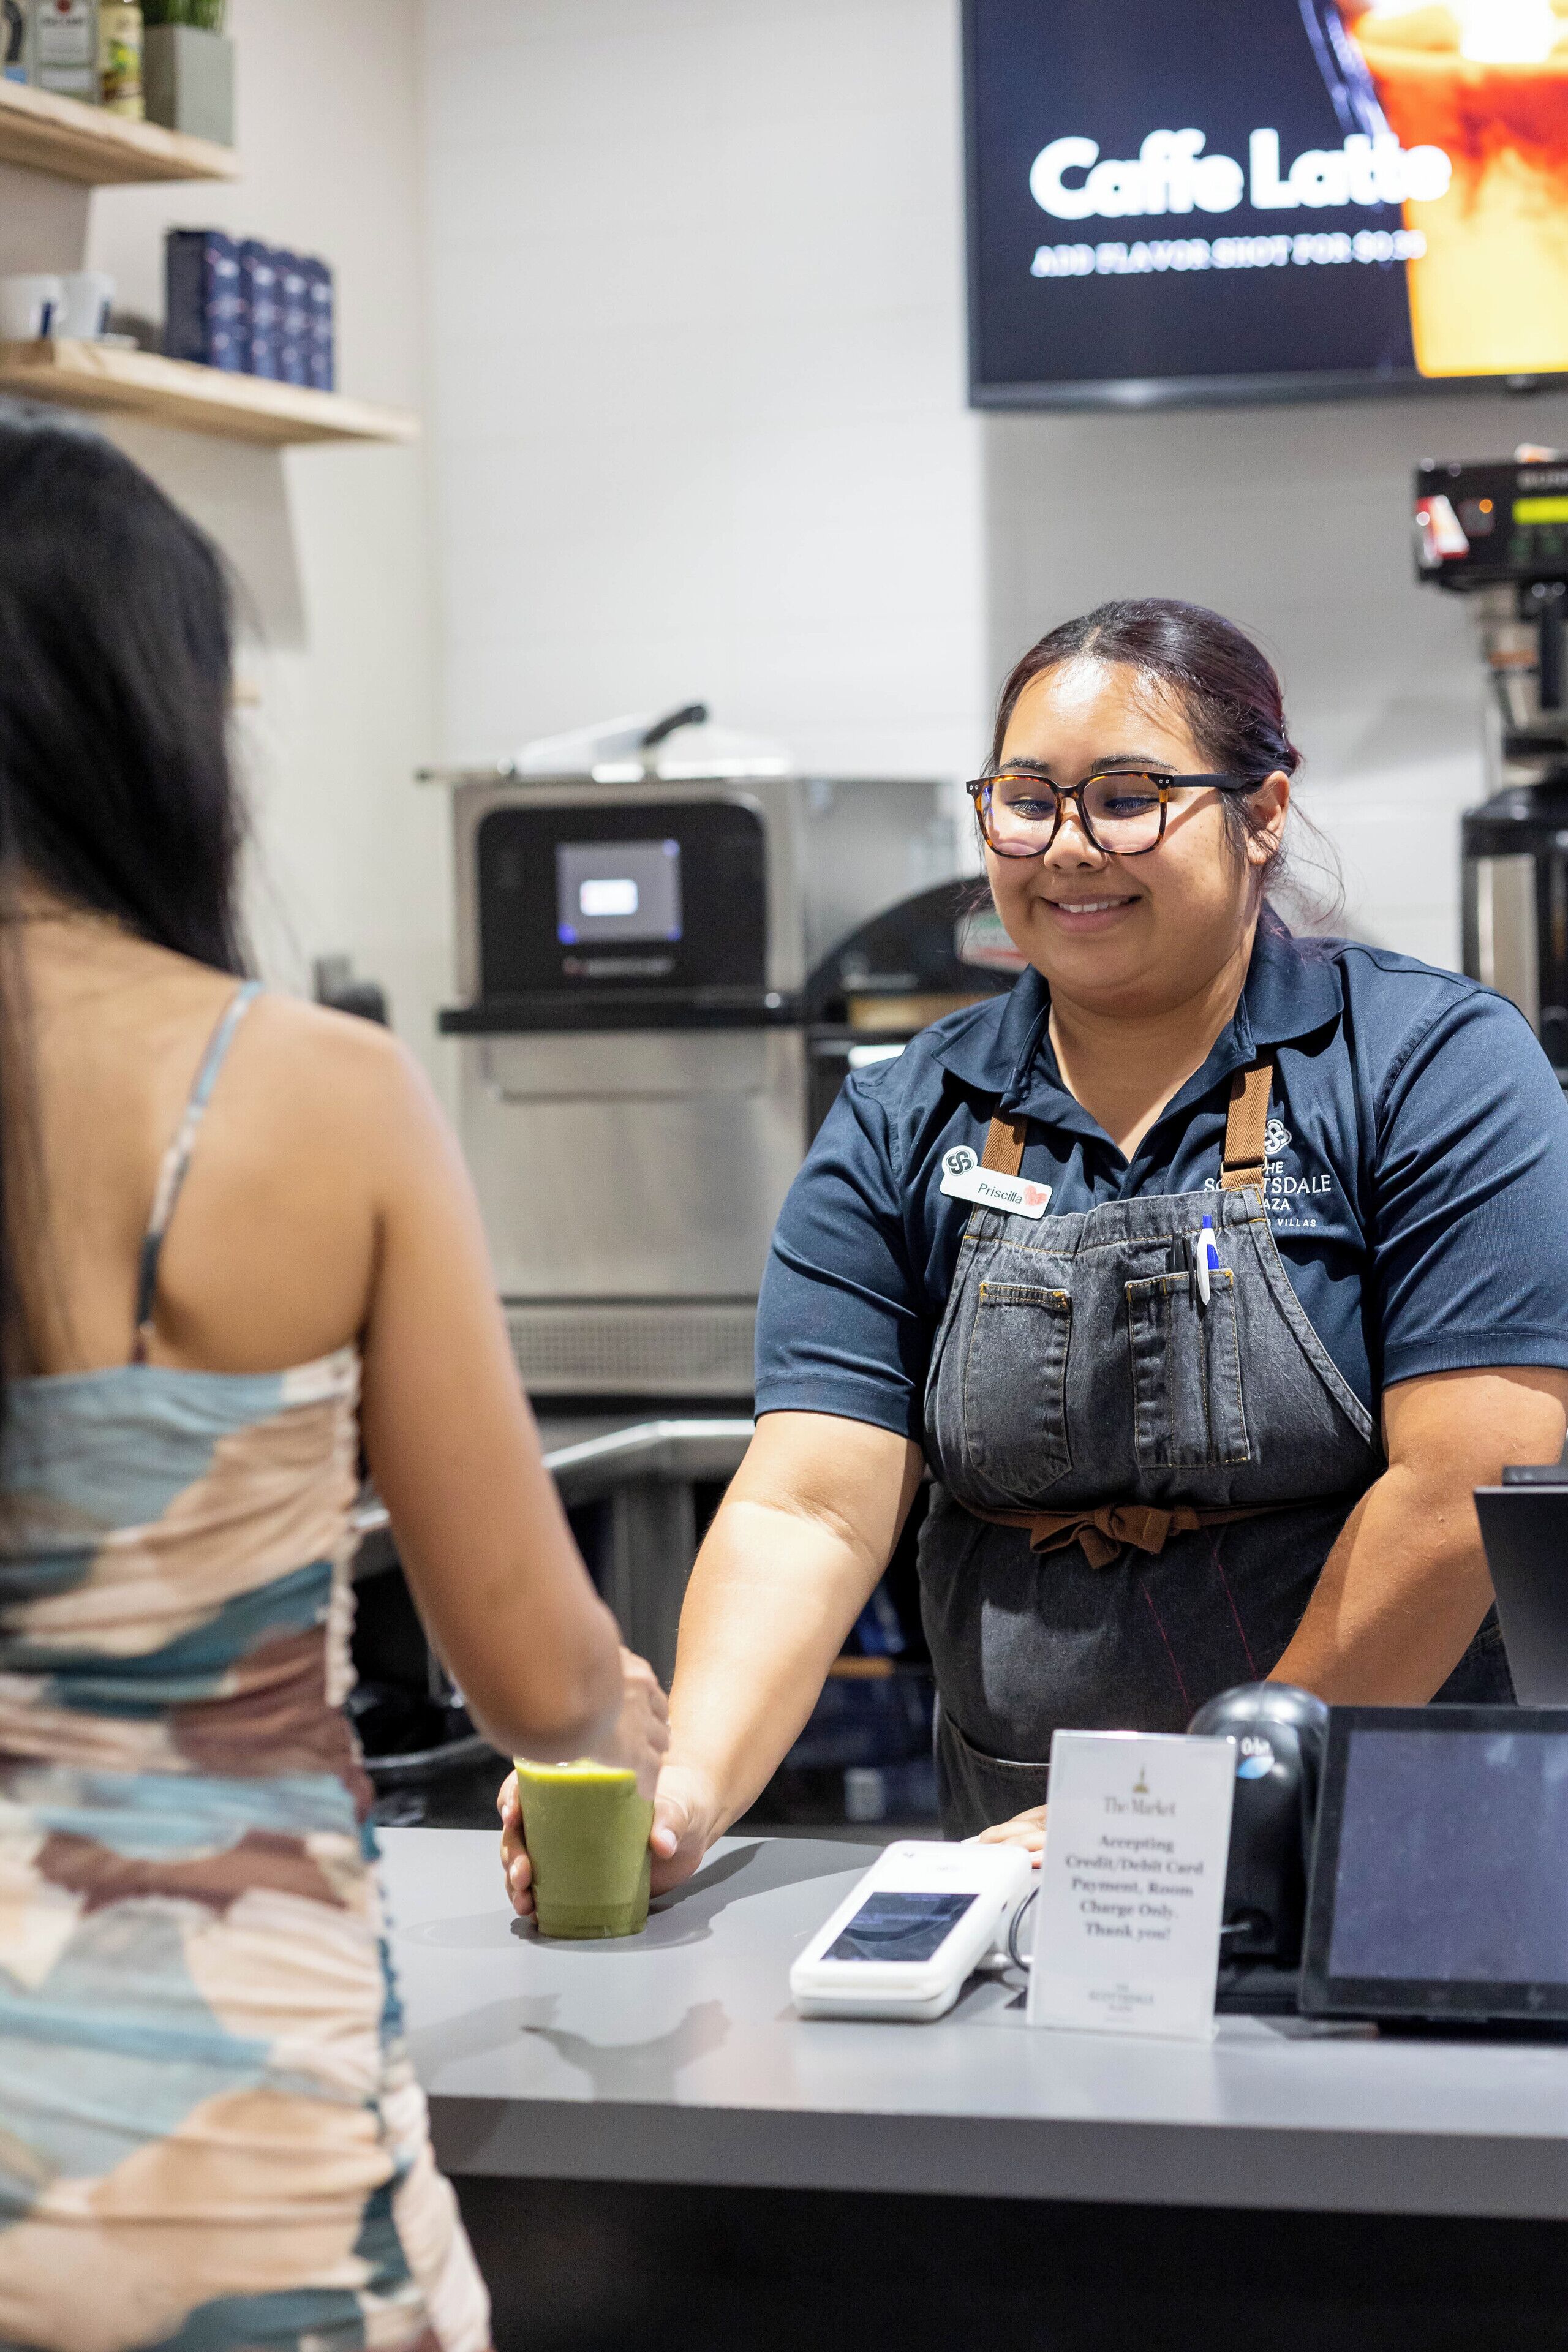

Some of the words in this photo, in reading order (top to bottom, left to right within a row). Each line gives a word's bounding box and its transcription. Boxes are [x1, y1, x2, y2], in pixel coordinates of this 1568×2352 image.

[1030, 128, 1244, 221] Caffe
[1250, 127, 1452, 209] Latte
[1030, 244, 1095, 277] ADD
[1096, 238, 1211, 274] FLAVOR
[1211, 235, 1292, 270] SHOT
[1291, 232, 1352, 265] FOR
[978, 1183, 1022, 1204] Priscilla
[1264, 1198, 1291, 1210] AZA
[1278, 1219, 1316, 1227] VILLAS
[1104, 1796, 1128, 1814] The
[1131, 1799, 1176, 1817] Market
[1101, 1836, 1174, 1853] Accepting
[1065, 1854, 1162, 1872] Credit/Debit
[1166, 1860, 1204, 1875] Card
[1071, 1876, 1142, 1894] Payment,
[1148, 1882, 1194, 1896] Room
[1080, 1900, 1133, 1918] Charge
[1086, 1922, 1132, 1939] Thank
[1136, 1927, 1171, 1942] you!
